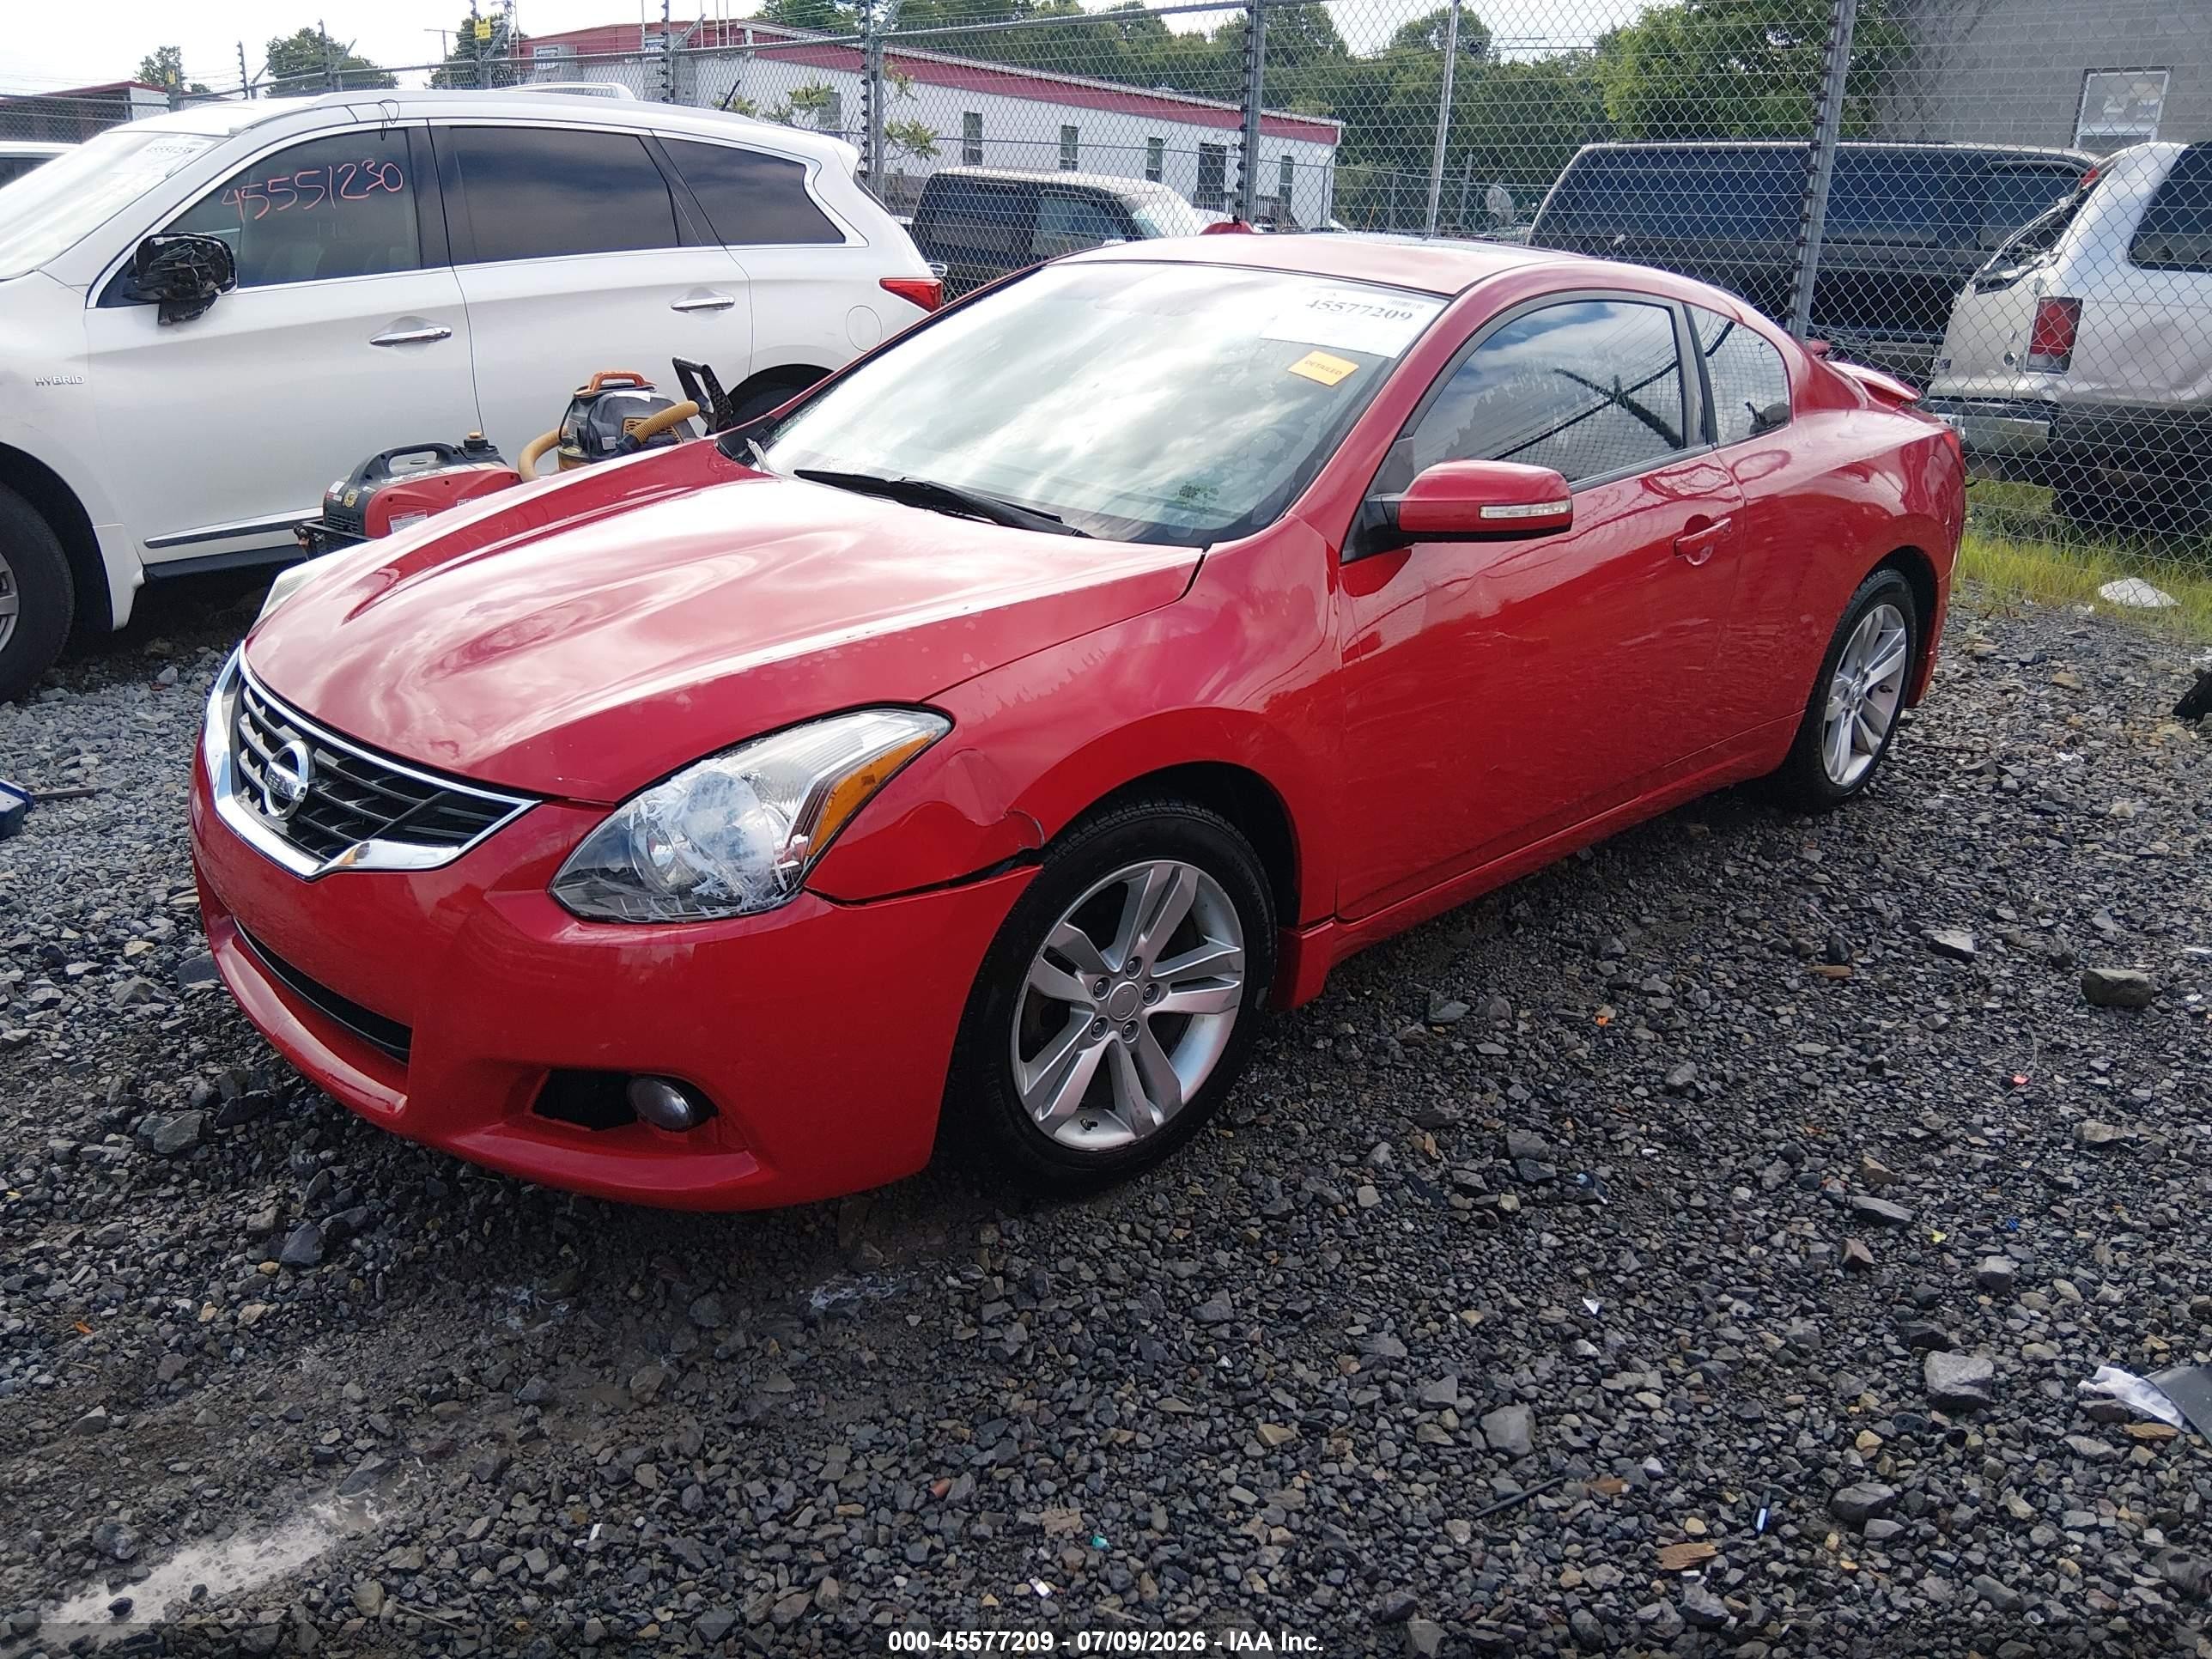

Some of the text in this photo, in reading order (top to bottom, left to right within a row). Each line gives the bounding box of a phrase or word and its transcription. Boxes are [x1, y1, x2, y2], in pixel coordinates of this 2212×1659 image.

[221, 158, 404, 222] 45551230
[1305, 298, 1413, 321] 45577209
[1304, 360, 1343, 375] DETAILED
[34, 375, 84, 386] HYBRID
